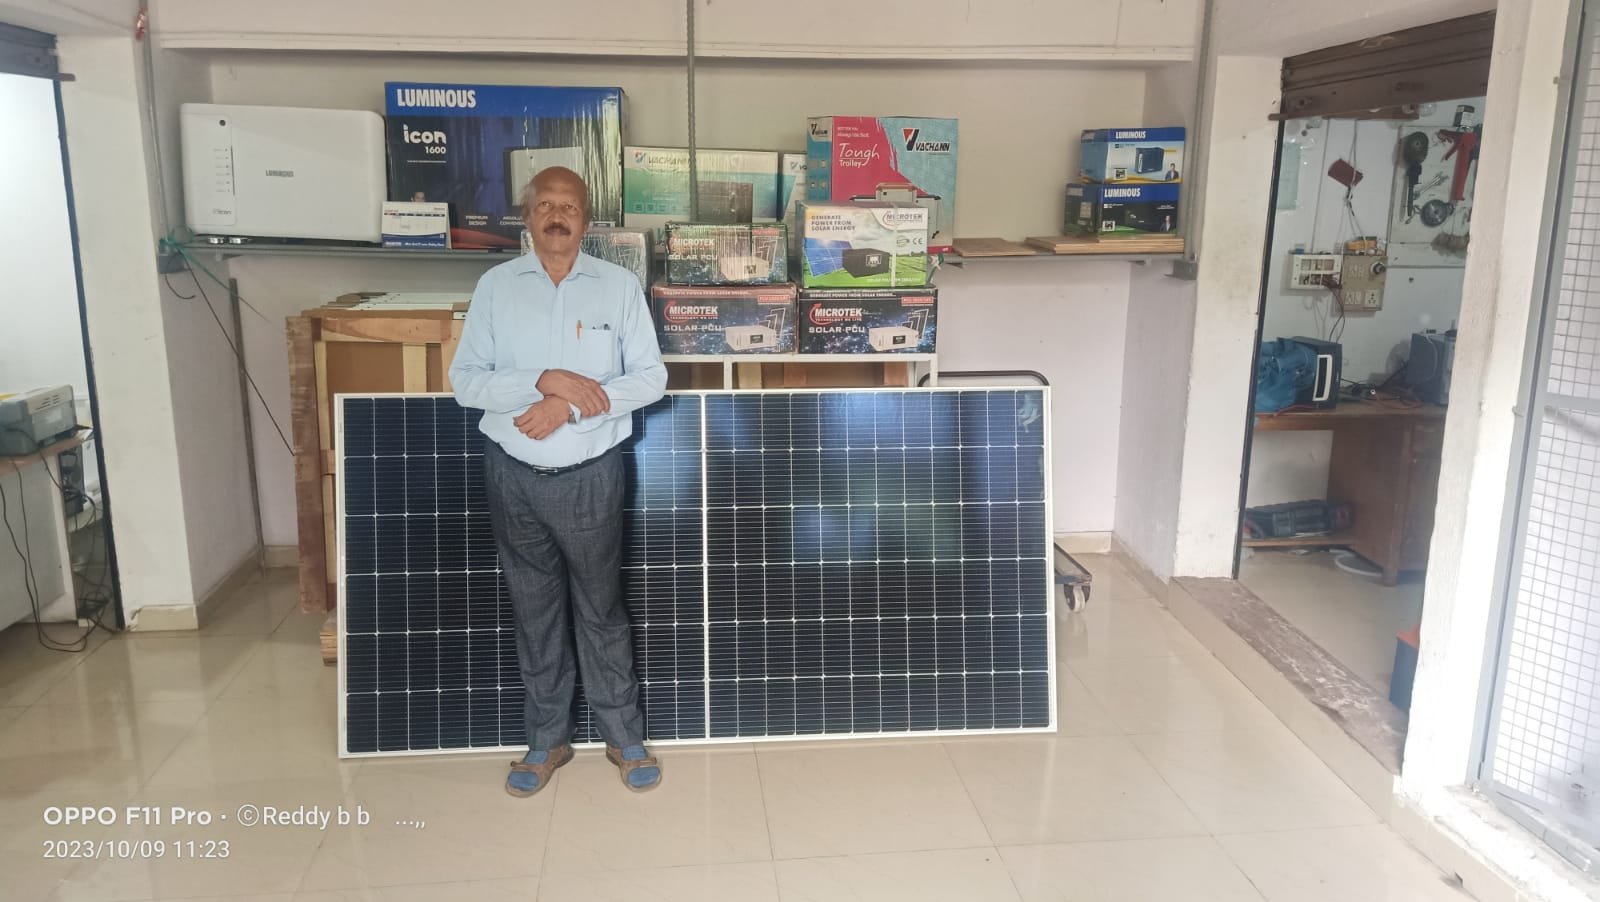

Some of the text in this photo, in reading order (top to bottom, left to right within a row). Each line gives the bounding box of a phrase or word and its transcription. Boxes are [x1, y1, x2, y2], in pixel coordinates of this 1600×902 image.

[397, 88, 476, 108] LUMINOUS
[403, 124, 447, 144] icon
[1115, 131, 1146, 139] LUMINOUS
[425, 146, 447, 154] 1600
[915, 142, 951, 151] VACHANN
[839, 143, 880, 165] Tough
[839, 160, 862, 168] Trolley
[1104, 188, 1141, 198] LUMINOUS
[672, 238, 716, 246] MICROTEK
[669, 306, 719, 315] MICROTEK
[815, 308, 863, 317] MICROTEK
[663, 324, 722, 332] SOLAR PCU
